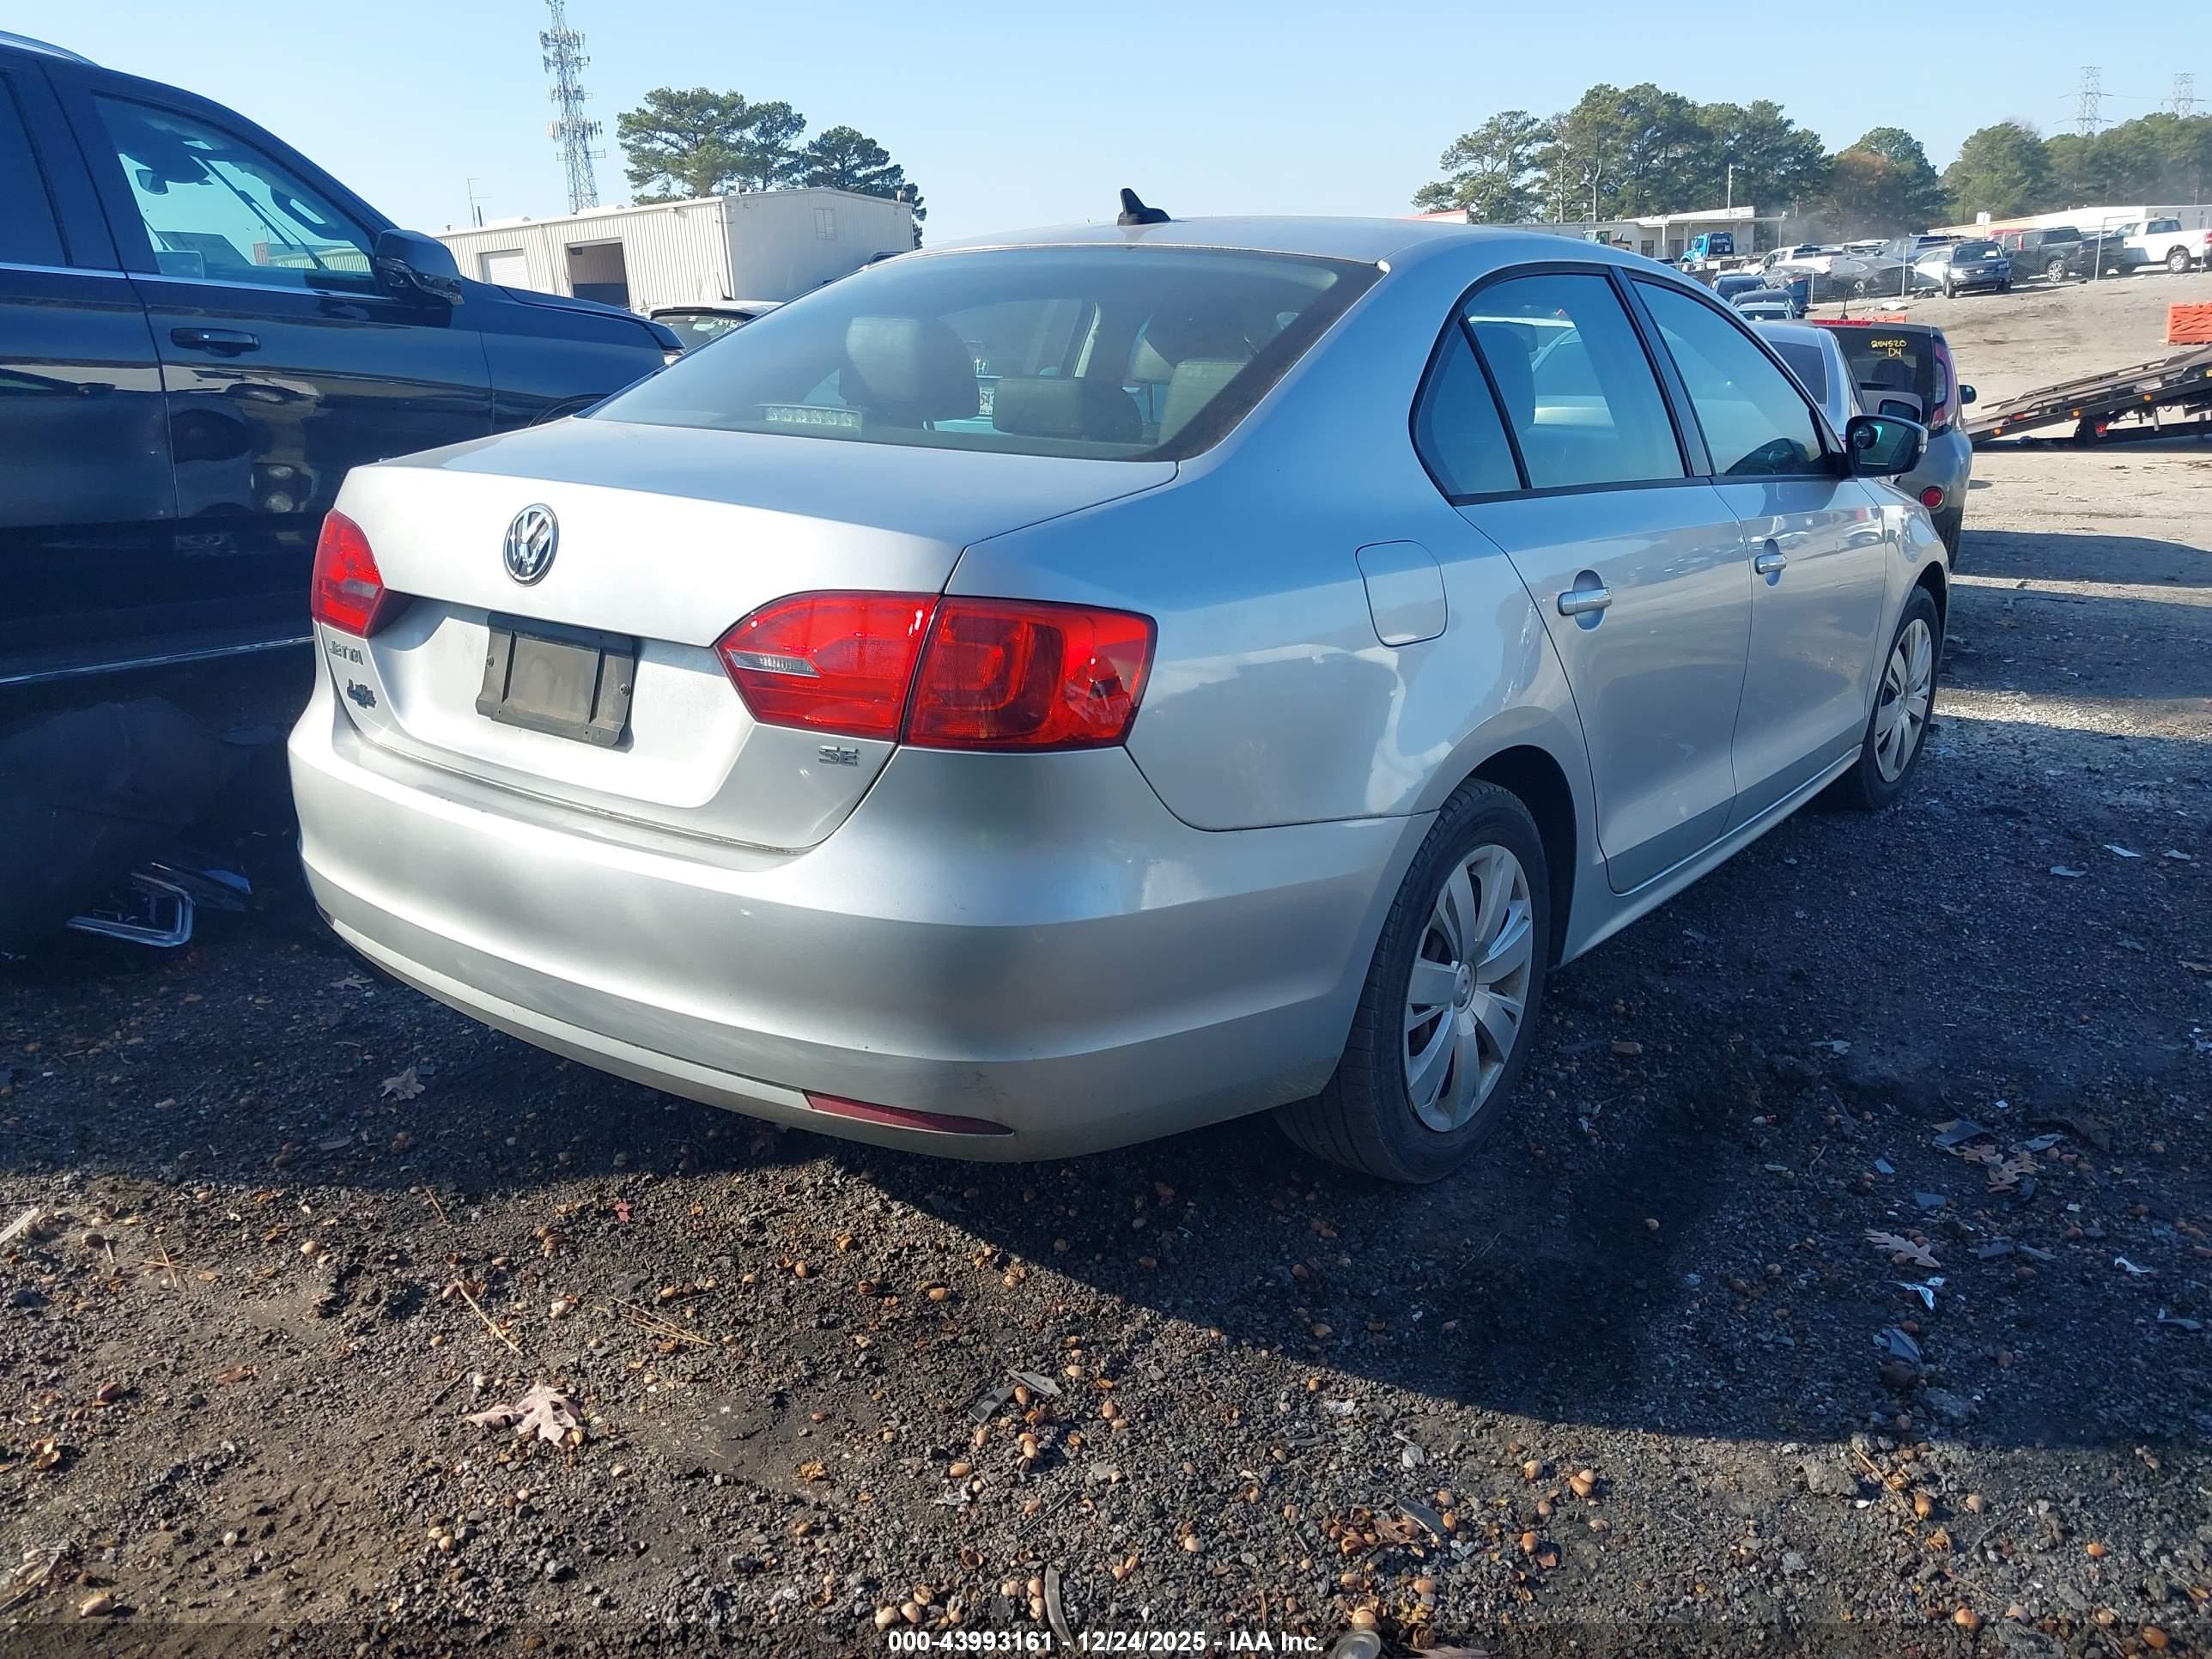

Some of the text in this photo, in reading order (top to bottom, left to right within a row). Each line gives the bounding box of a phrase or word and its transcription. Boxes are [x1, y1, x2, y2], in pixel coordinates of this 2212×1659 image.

[1887, 347, 1902, 358] D4
[329, 640, 364, 666] JETTA
[817, 744, 859, 767] SE
